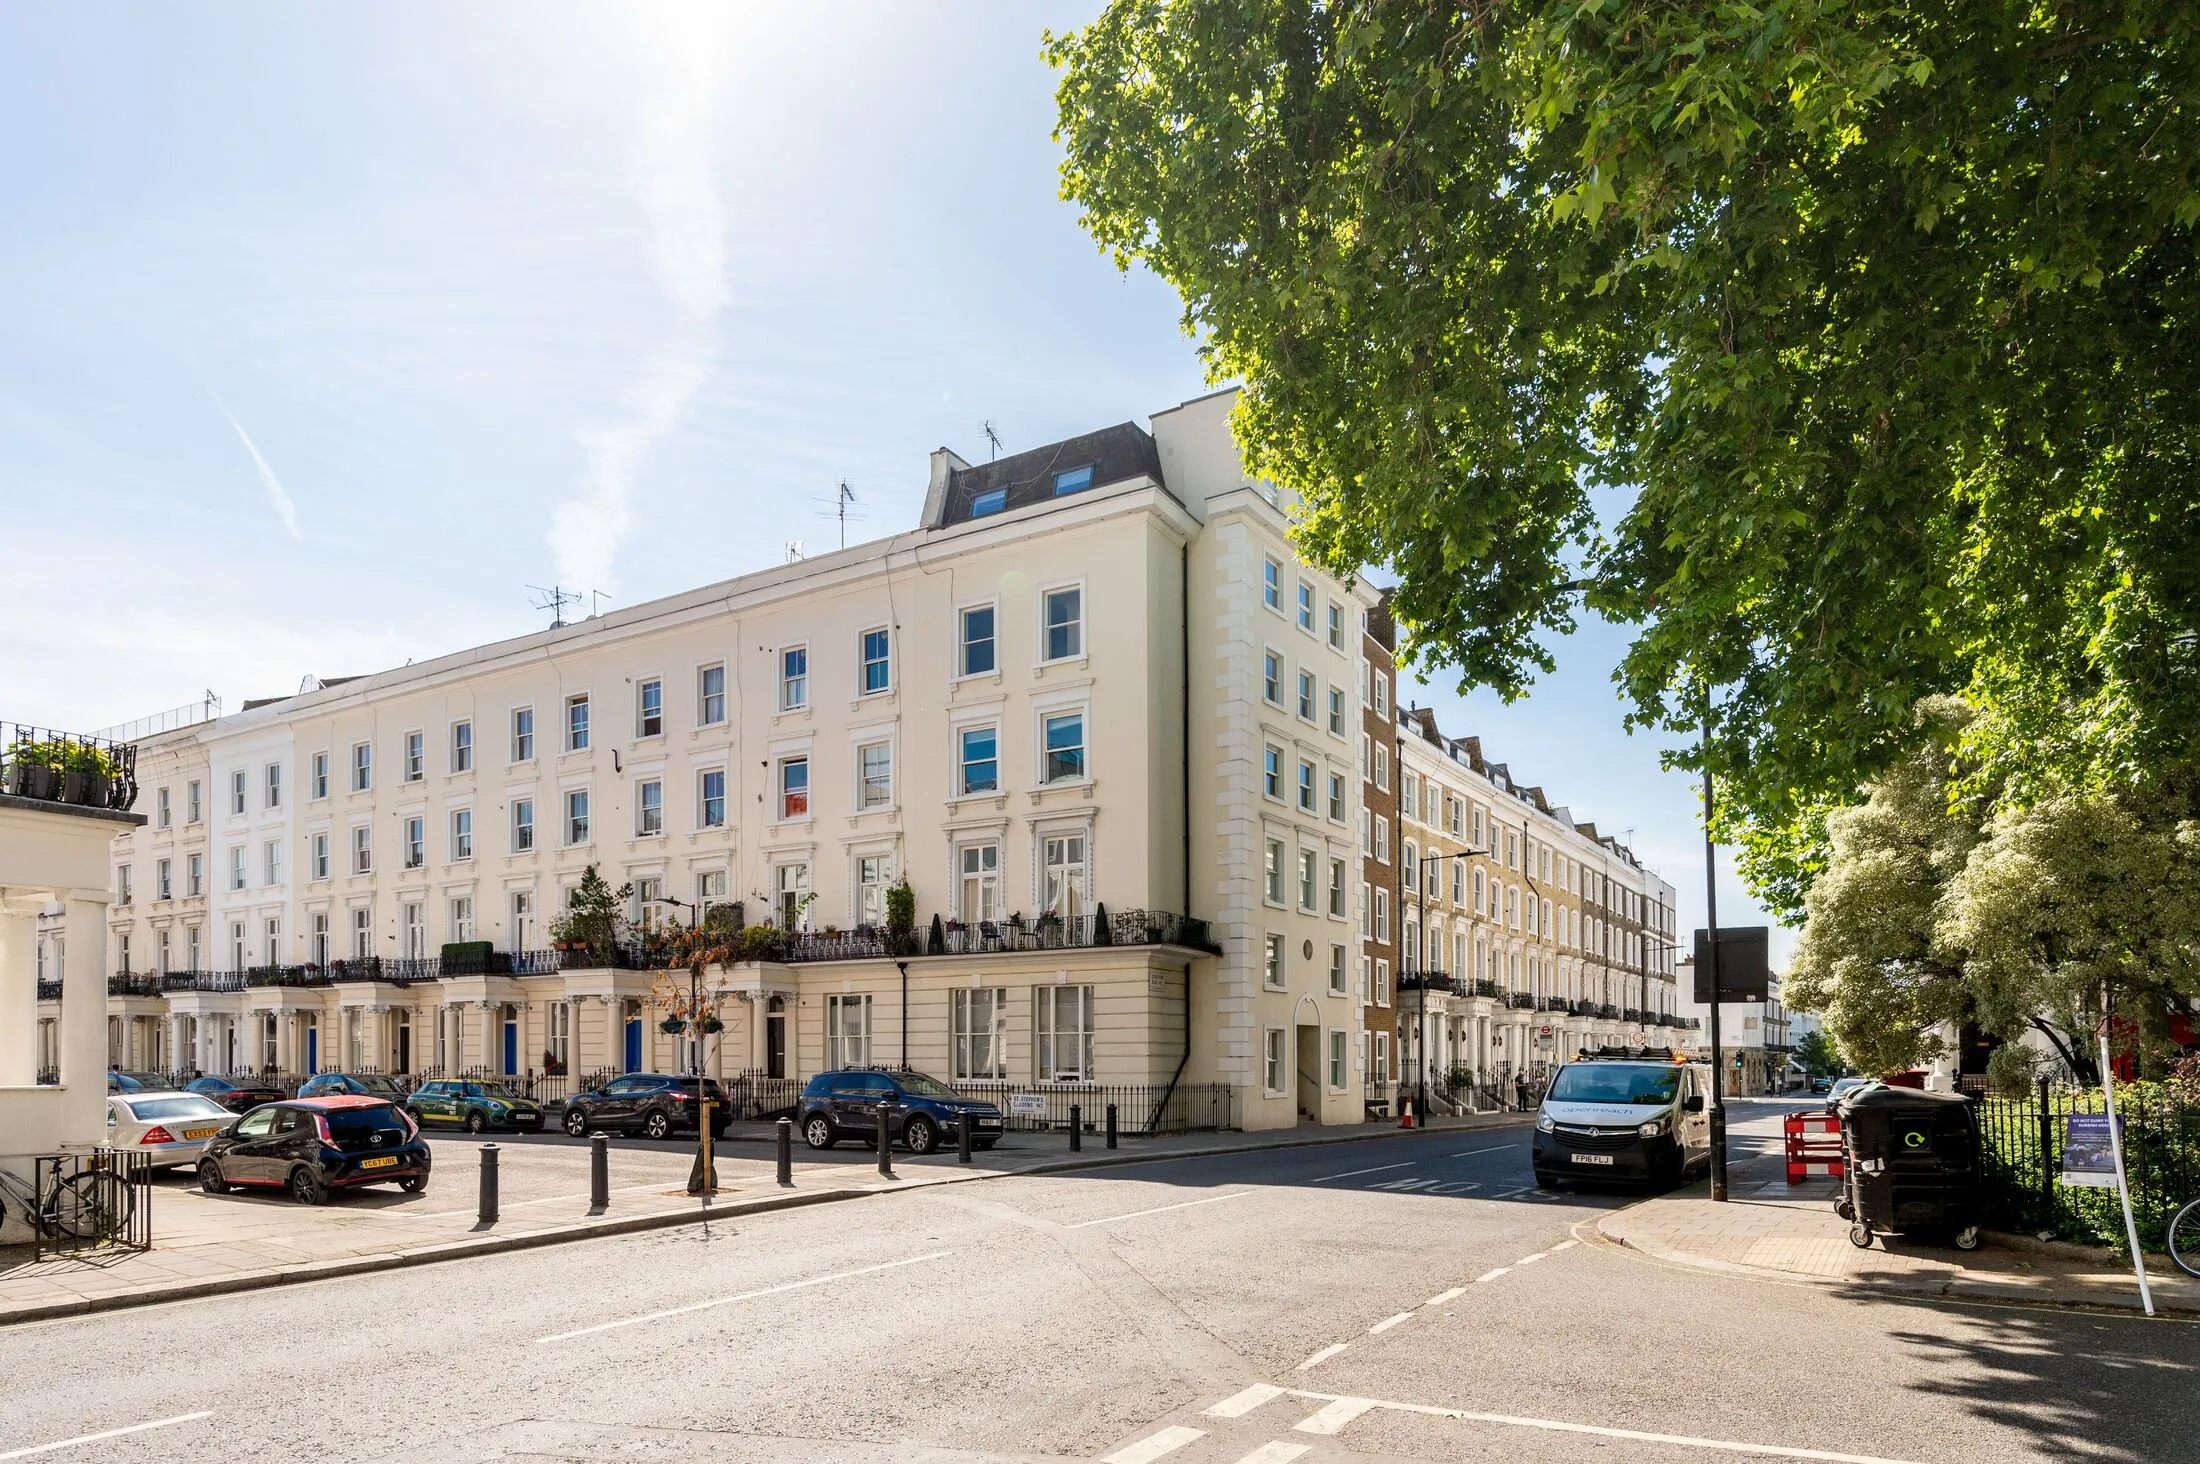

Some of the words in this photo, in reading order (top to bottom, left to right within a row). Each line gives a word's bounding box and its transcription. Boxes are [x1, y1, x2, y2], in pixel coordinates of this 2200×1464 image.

[1562, 1107, 1633, 1115] openreach
[363, 1159, 381, 1168] YC67
[382, 1157, 396, 1165] UBE
[1575, 1155, 1593, 1163] FP16
[1593, 1156, 1609, 1164] FLJ
